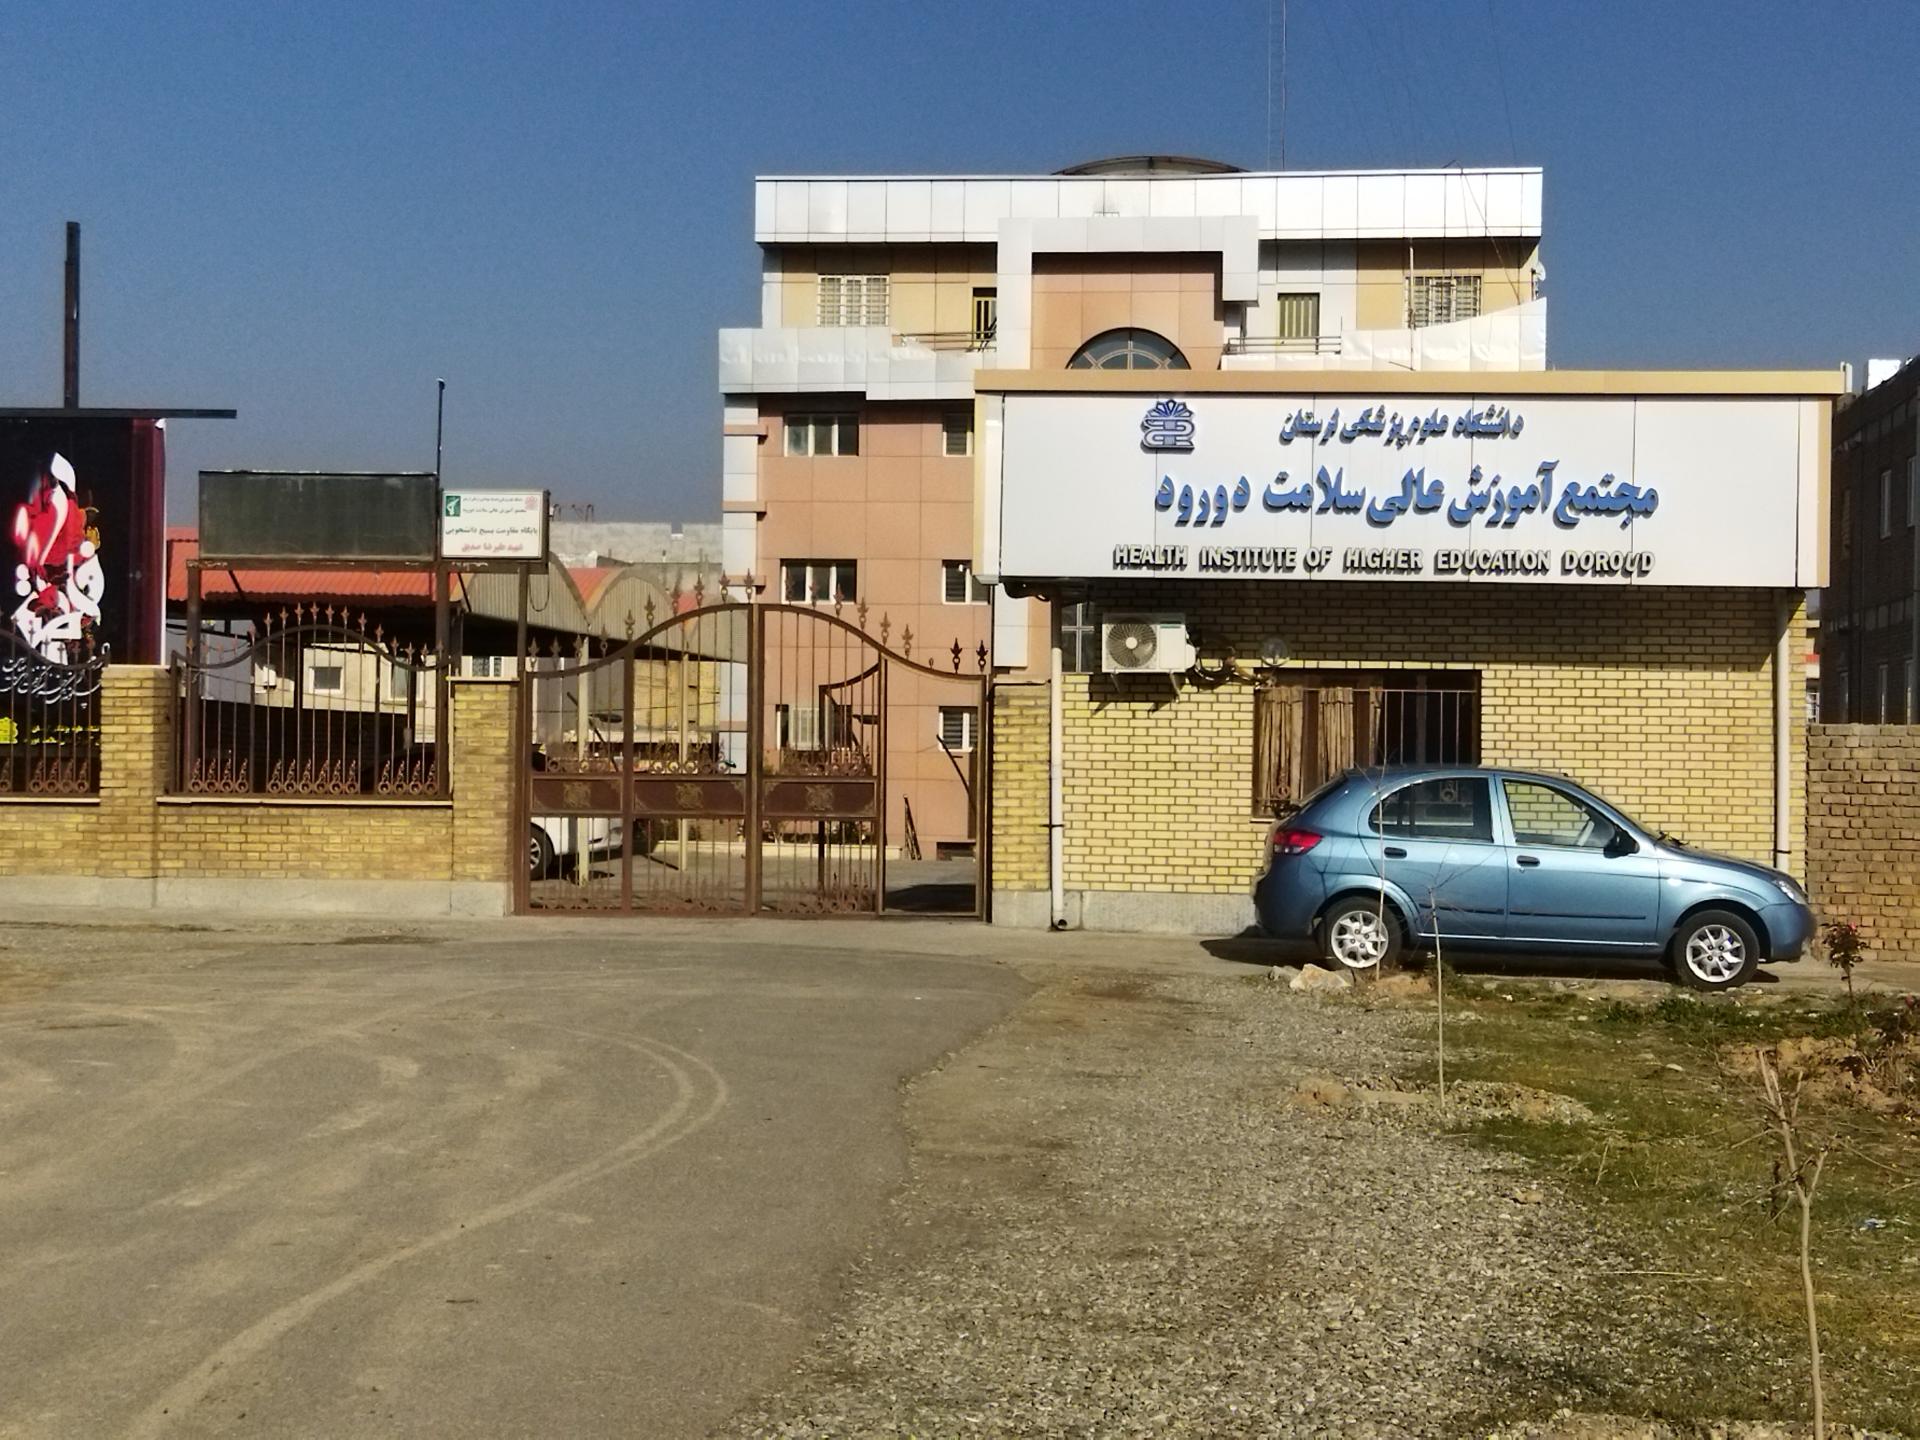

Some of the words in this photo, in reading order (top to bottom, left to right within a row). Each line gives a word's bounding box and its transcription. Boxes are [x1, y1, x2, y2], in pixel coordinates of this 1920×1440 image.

[1279, 407, 1340, 445] لرستان
[1339, 404, 1406, 450] پزشکی
[1408, 408, 1449, 445] علوم
[1452, 404, 1524, 439] دانشگاه
[1155, 475, 1251, 528] دورود
[1263, 465, 1367, 515] سلامت
[1366, 467, 1445, 528] عالی
[1448, 460, 1560, 529] آموزش
[1553, 473, 1659, 530] مجتمع
[1113, 544, 1189, 570] HEALTH
[1200, 546, 1297, 573] INSTITUTE
[1303, 546, 1333, 573] OF
[1343, 547, 1424, 574] HIGHER
[1434, 549, 1552, 576] EDUCATION
[1562, 550, 1656, 577] DOROUD
